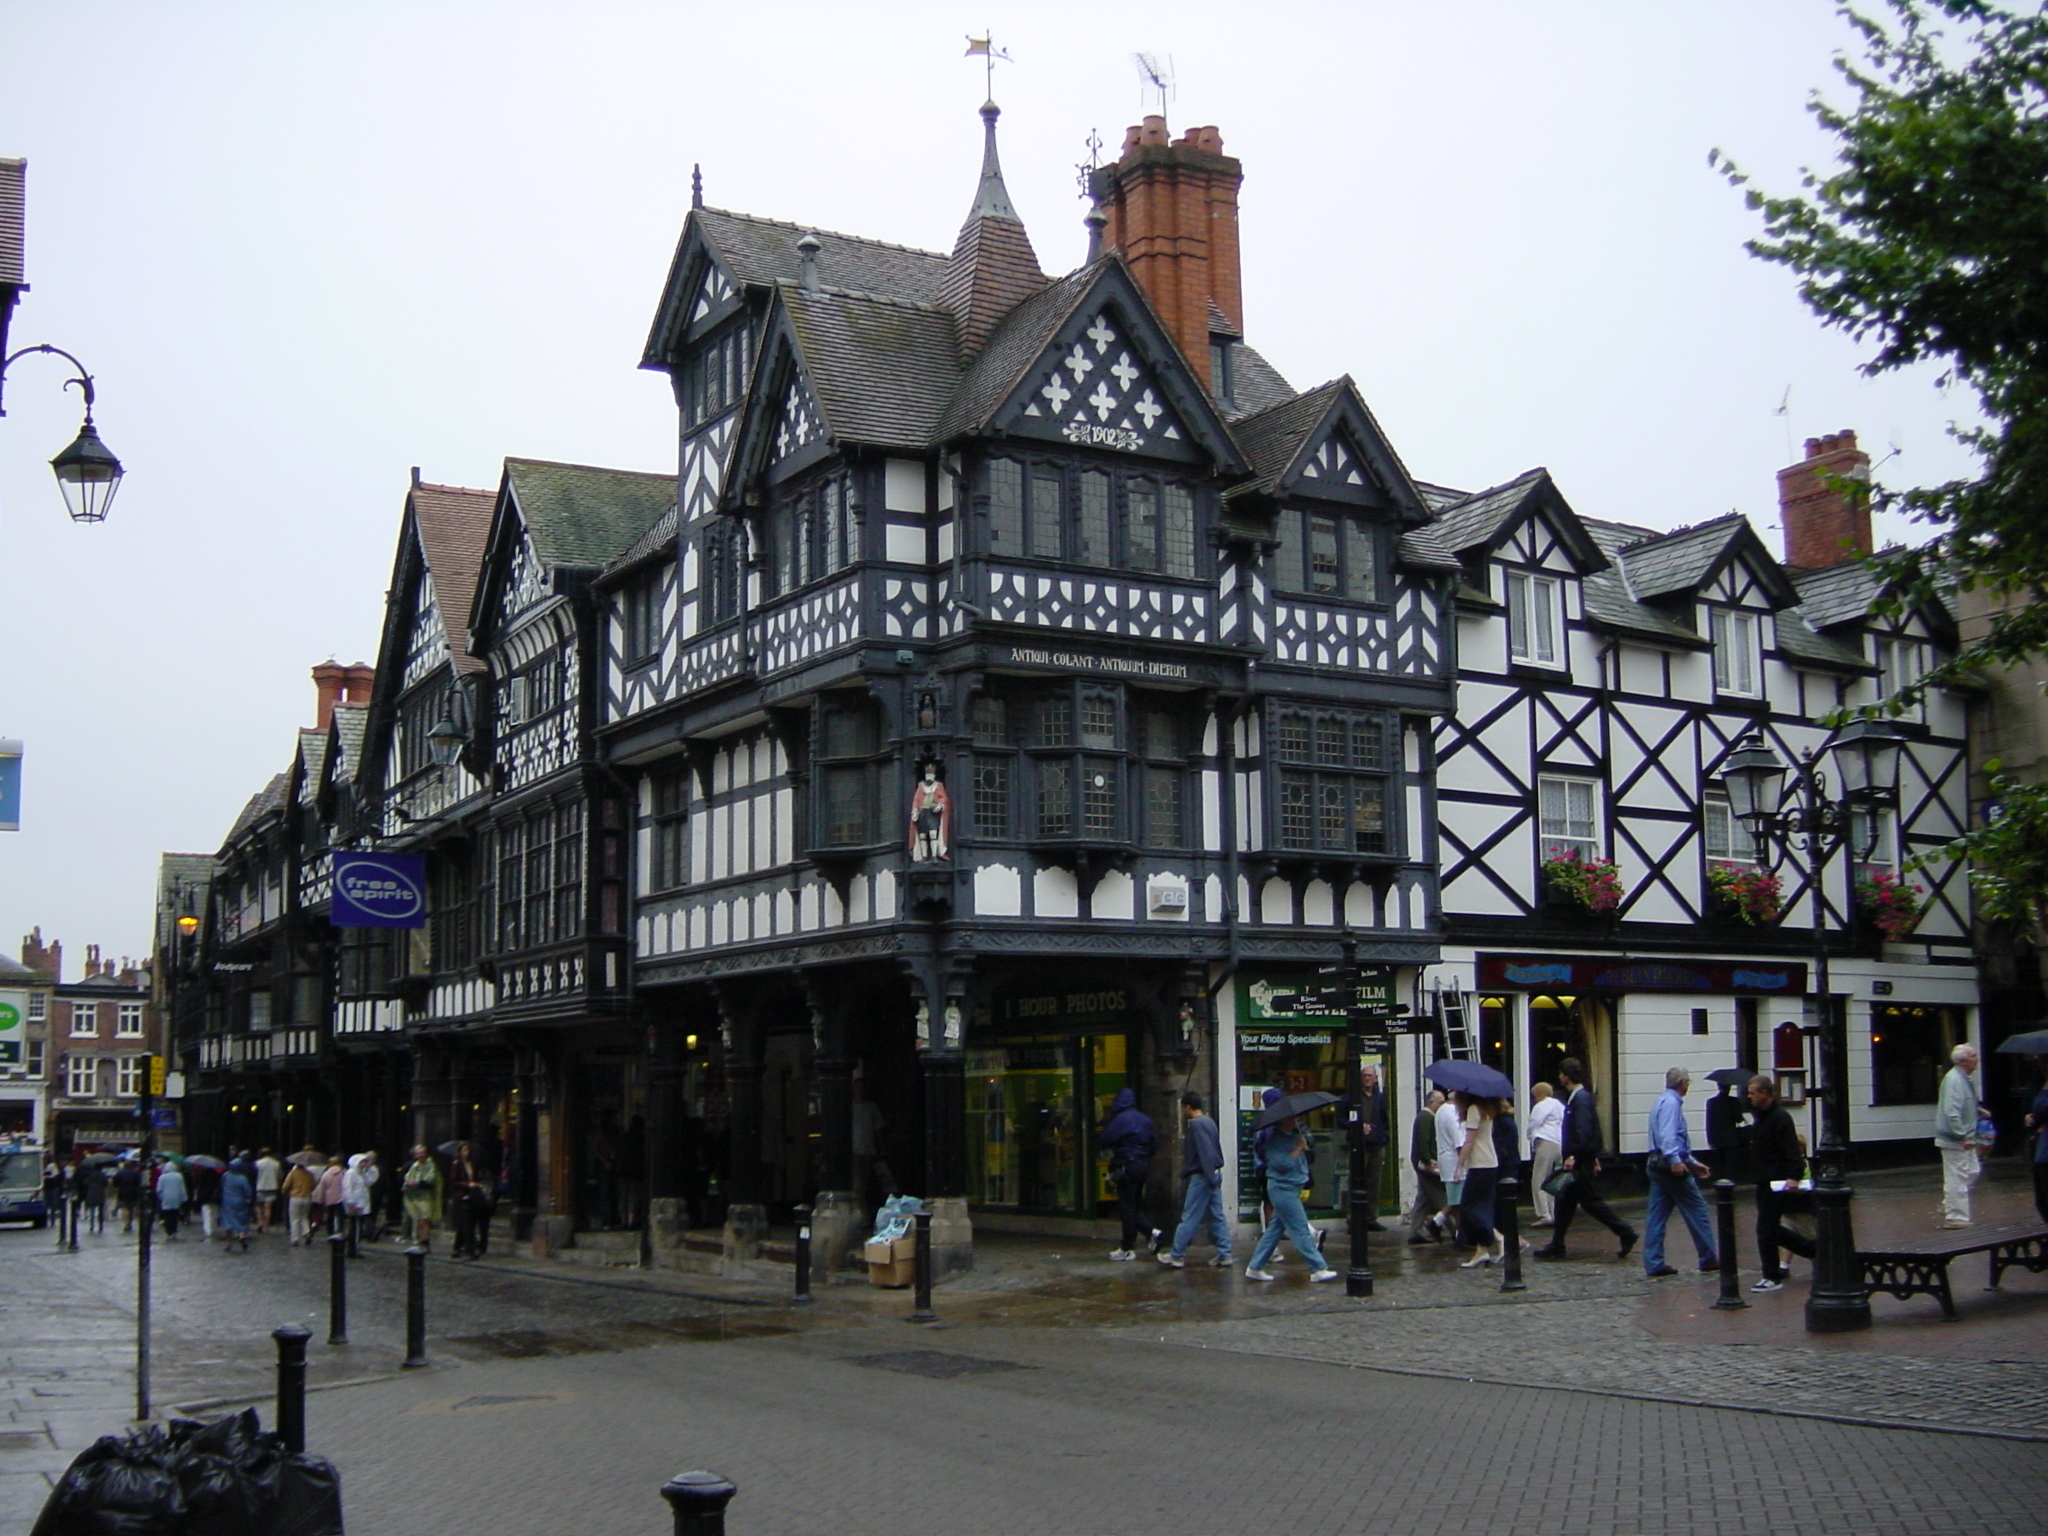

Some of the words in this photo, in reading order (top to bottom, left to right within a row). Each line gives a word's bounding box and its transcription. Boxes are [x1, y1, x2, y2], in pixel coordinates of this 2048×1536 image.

[1092, 426, 1117, 446] 1902
[1012, 648, 1048, 664] ANTIQUI
[1053, 652, 1093, 668] COLANT
[1149, 662, 1187, 678] DIERUM
[346, 877, 397, 890] free
[350, 889, 414, 900] spirit
[1019, 997, 1058, 1017] HOUR
[1066, 991, 1126, 1013] PHOTOS
[1241, 1034, 1259, 1044] Your
[1260, 1034, 1286, 1044] Photo
[1287, 1033, 1332, 1046] Specialists
